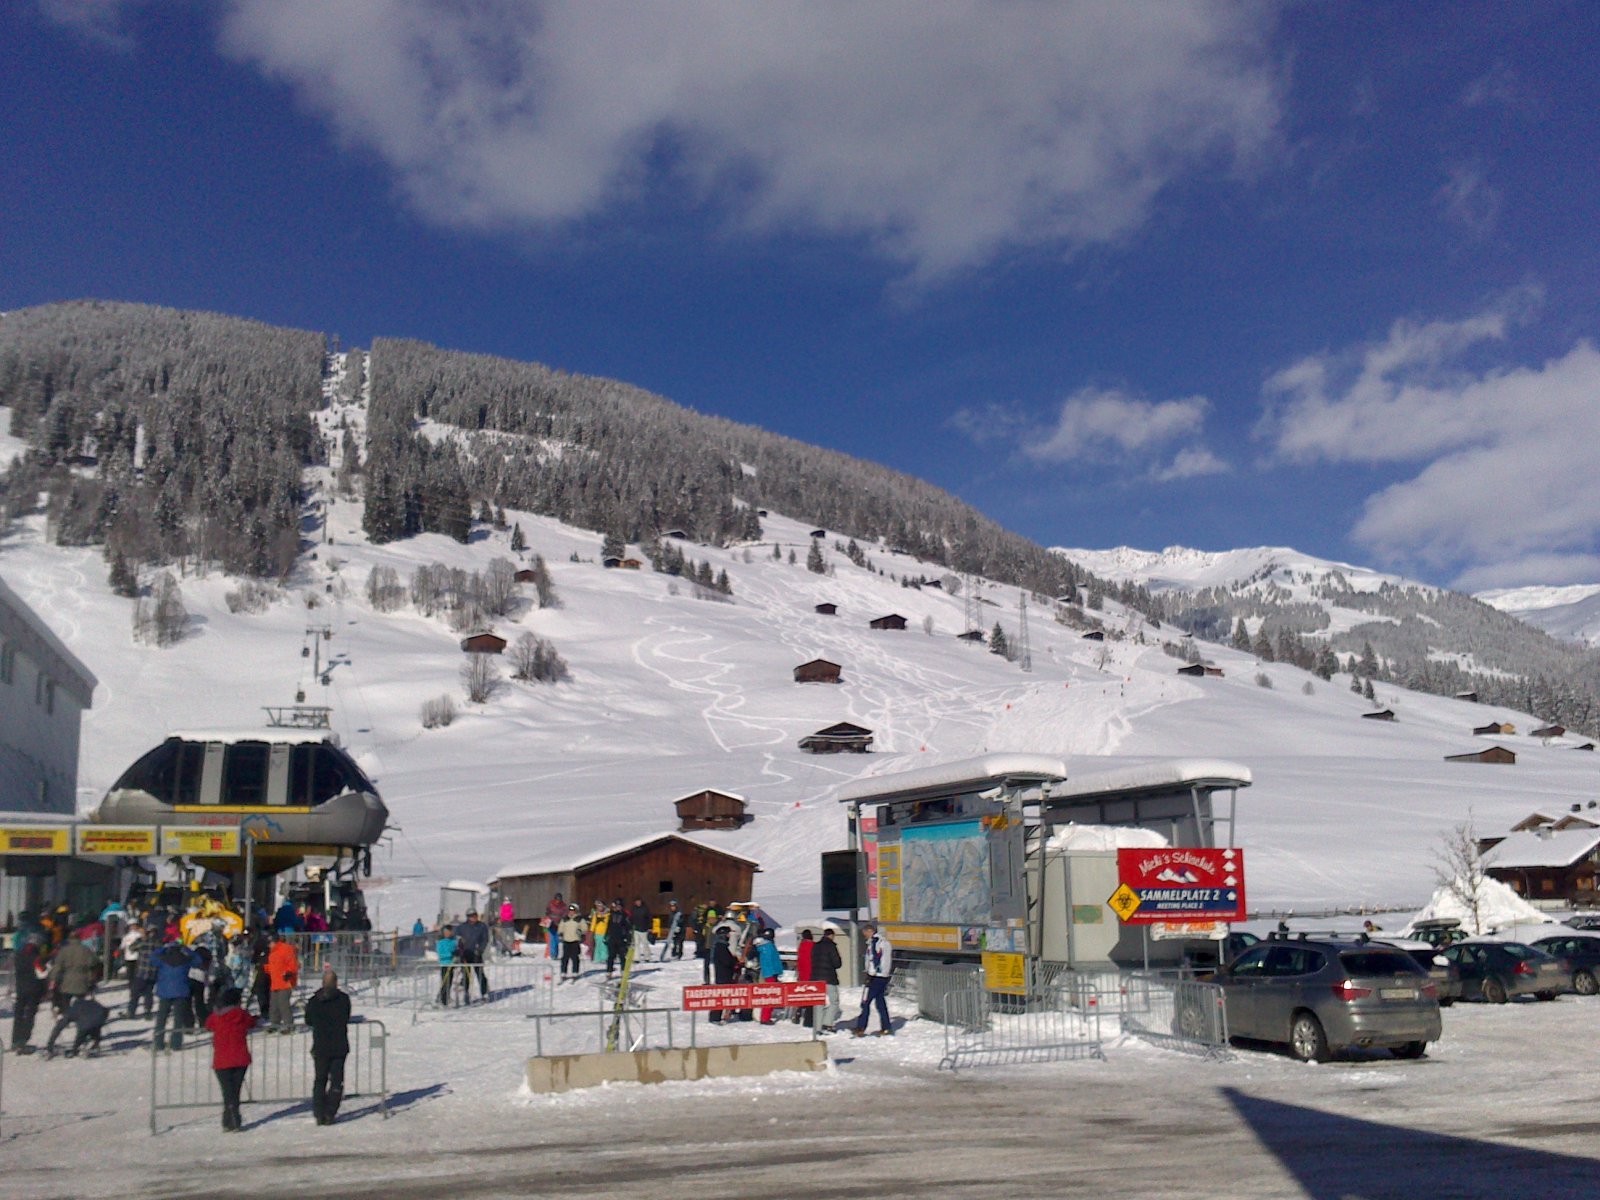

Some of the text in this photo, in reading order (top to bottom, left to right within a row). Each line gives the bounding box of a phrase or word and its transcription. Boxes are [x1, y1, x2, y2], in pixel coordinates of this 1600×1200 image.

[1140, 889, 1220, 901] SAMMELPLATZ 2
[685, 987, 748, 999] TAGESPARKPLATZ
[752, 986, 782, 997] Camping
